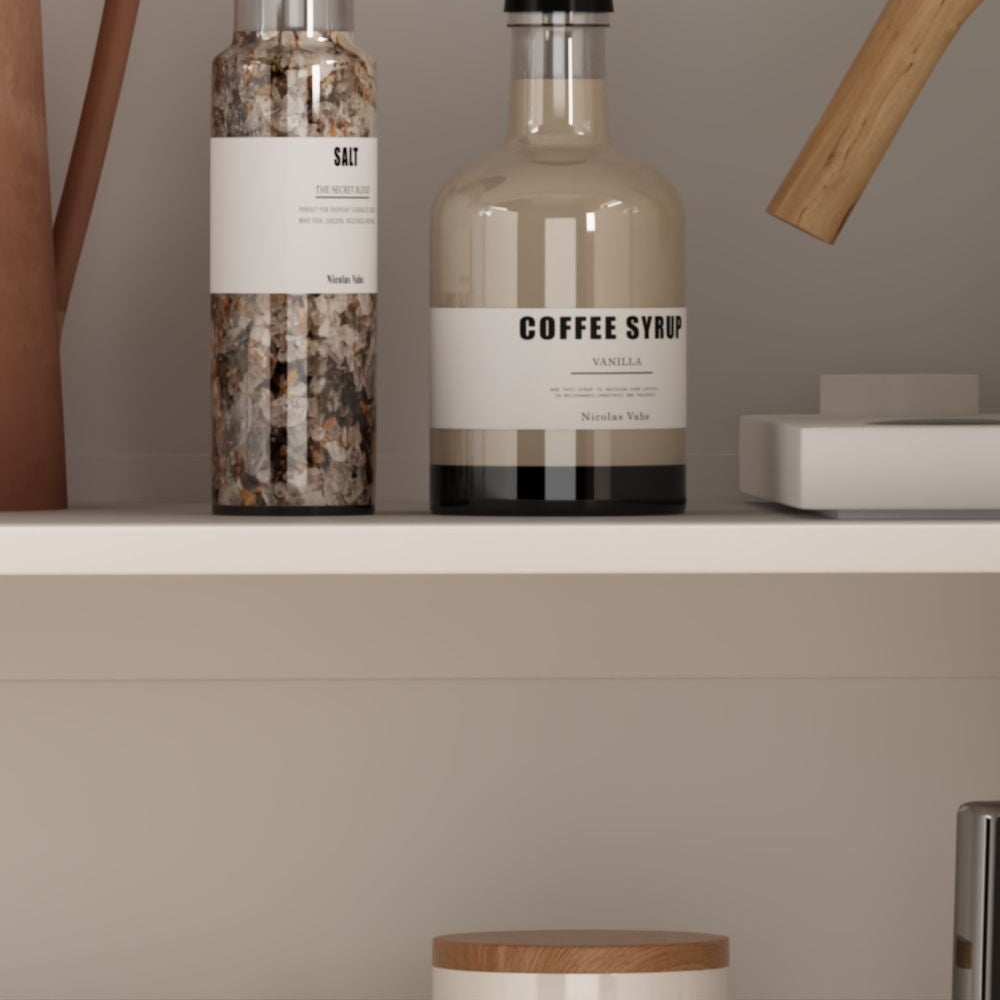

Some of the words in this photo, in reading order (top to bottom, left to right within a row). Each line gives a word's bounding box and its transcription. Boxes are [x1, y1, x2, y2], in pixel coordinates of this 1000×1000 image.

[334, 147, 359, 166] SALT
[316, 185, 329, 194] THE
[331, 185, 354, 195] SECRET
[519, 316, 617, 340] COFFEE
[626, 315, 682, 339] SYRUP
[592, 357, 643, 367] VANILLA
[581, 412, 623, 422] Nicolas
